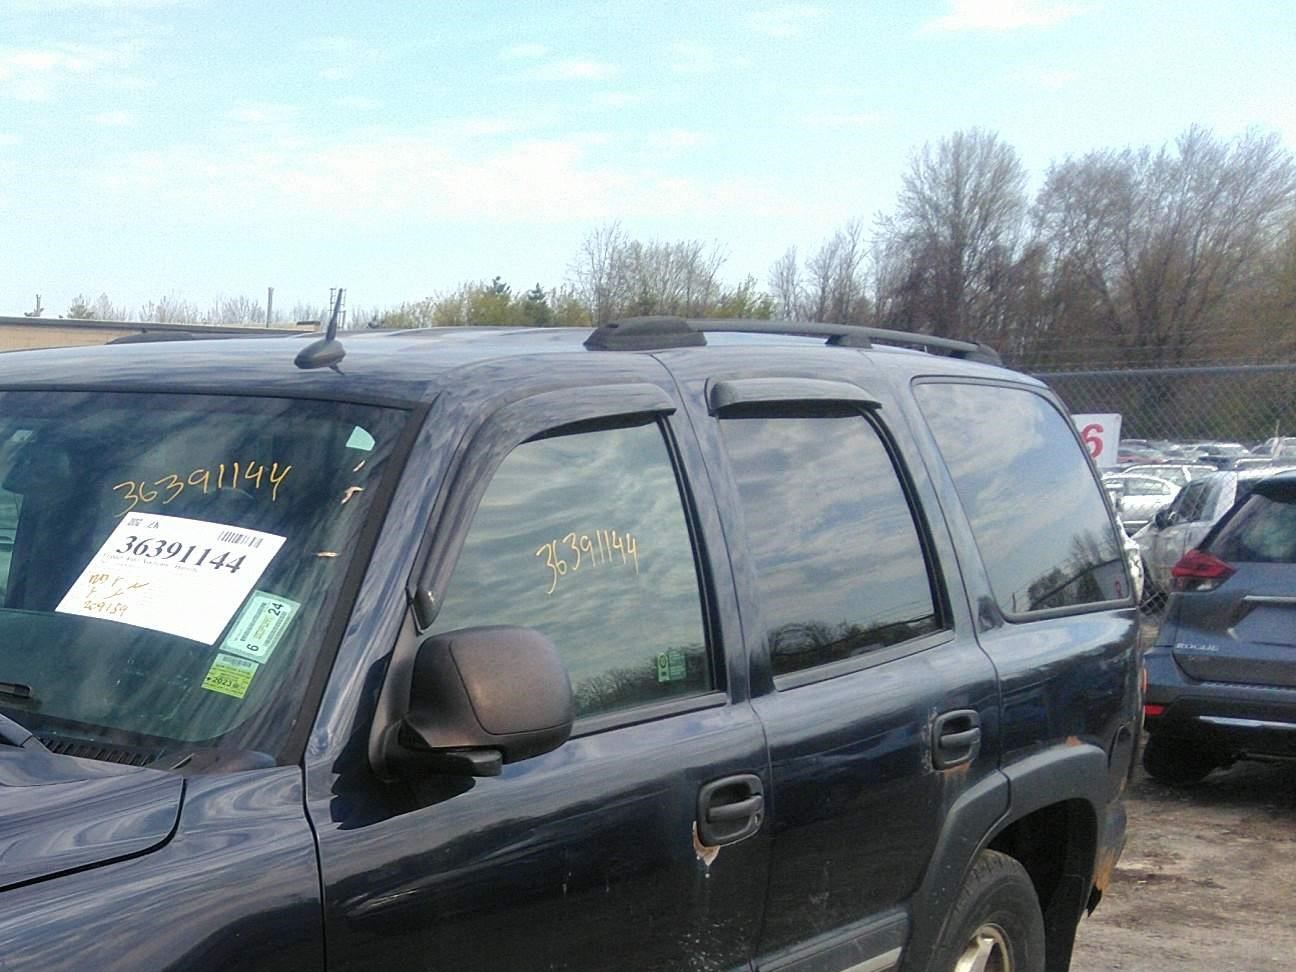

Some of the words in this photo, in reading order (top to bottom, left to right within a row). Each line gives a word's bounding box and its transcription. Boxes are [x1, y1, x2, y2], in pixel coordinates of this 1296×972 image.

[1081, 424, 1104, 458] 6
[113, 461, 292, 518] 36391144
[116, 535, 247, 574] 36391144
[536, 530, 639, 594] 36391144
[246, 643, 260, 652] 6
[267, 602, 284, 616] 24
[212, 675, 233, 688] 2023
